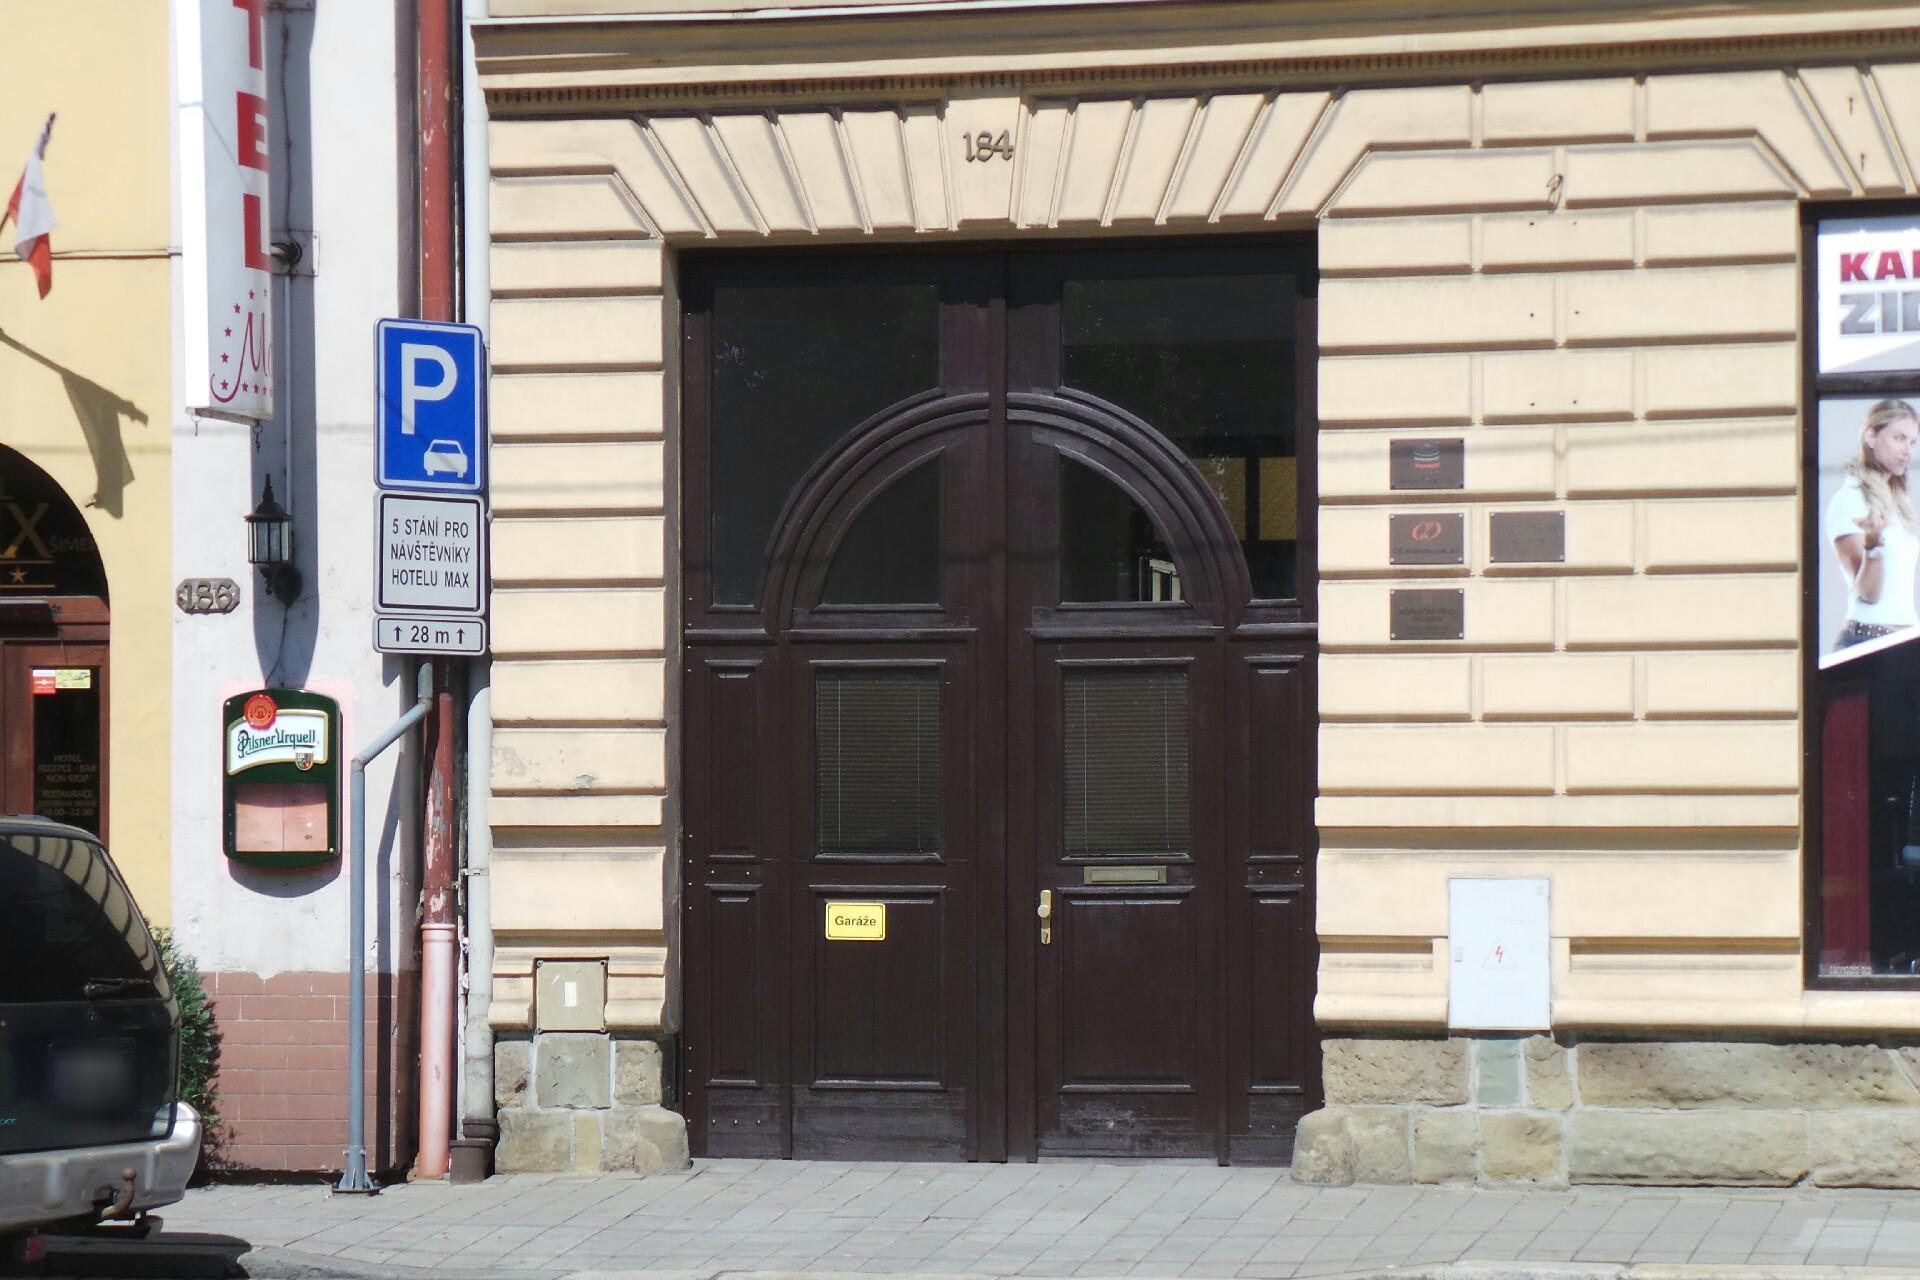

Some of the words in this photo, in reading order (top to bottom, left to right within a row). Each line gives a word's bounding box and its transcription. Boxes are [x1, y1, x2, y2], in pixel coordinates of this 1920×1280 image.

[963, 129, 1014, 162] 184
[401, 342, 458, 435] P
[392, 518, 399, 534] 5
[405, 515, 438, 537] STÁNÍ
[444, 521, 469, 538] PRO
[391, 540, 470, 563] NÁVŠTĚVNÍKY
[392, 568, 438, 586] HOTELU
[444, 571, 469, 588] MAX
[184, 582, 233, 610] 186
[410, 625, 429, 643] 28
[435, 630, 450, 643] m
[237, 729, 277, 759] Pilsner
[275, 728, 316, 749] Urquell
[834, 915, 877, 926] Garáže
